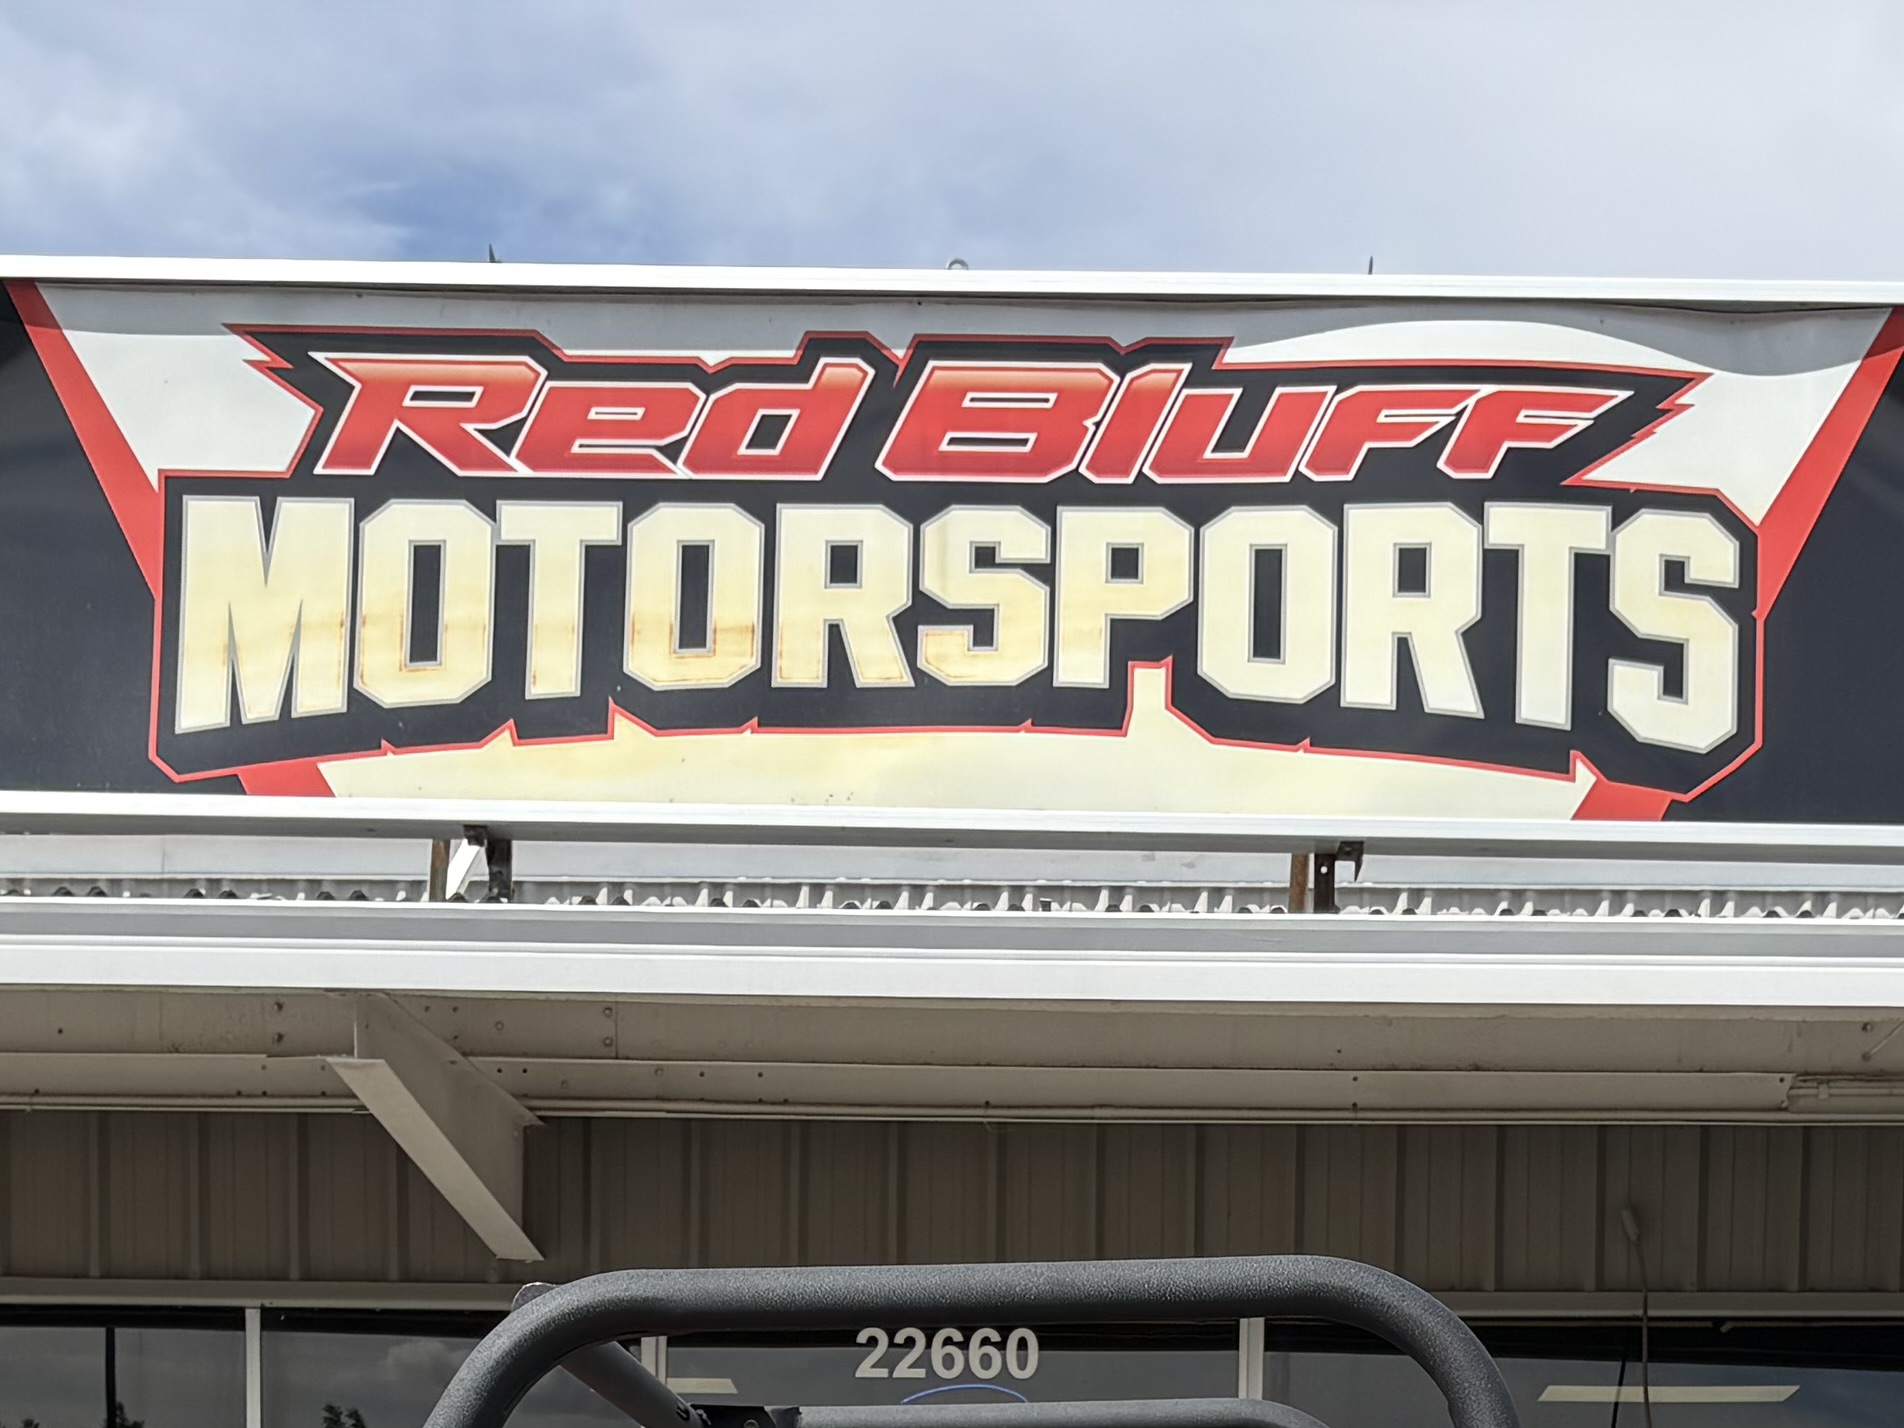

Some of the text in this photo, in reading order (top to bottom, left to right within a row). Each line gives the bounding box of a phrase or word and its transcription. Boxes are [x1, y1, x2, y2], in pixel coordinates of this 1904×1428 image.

[310, 352, 876, 482] Red
[172, 495, 1742, 756] MOTORSPORTS
[854, 1326, 1040, 1380] 22660
